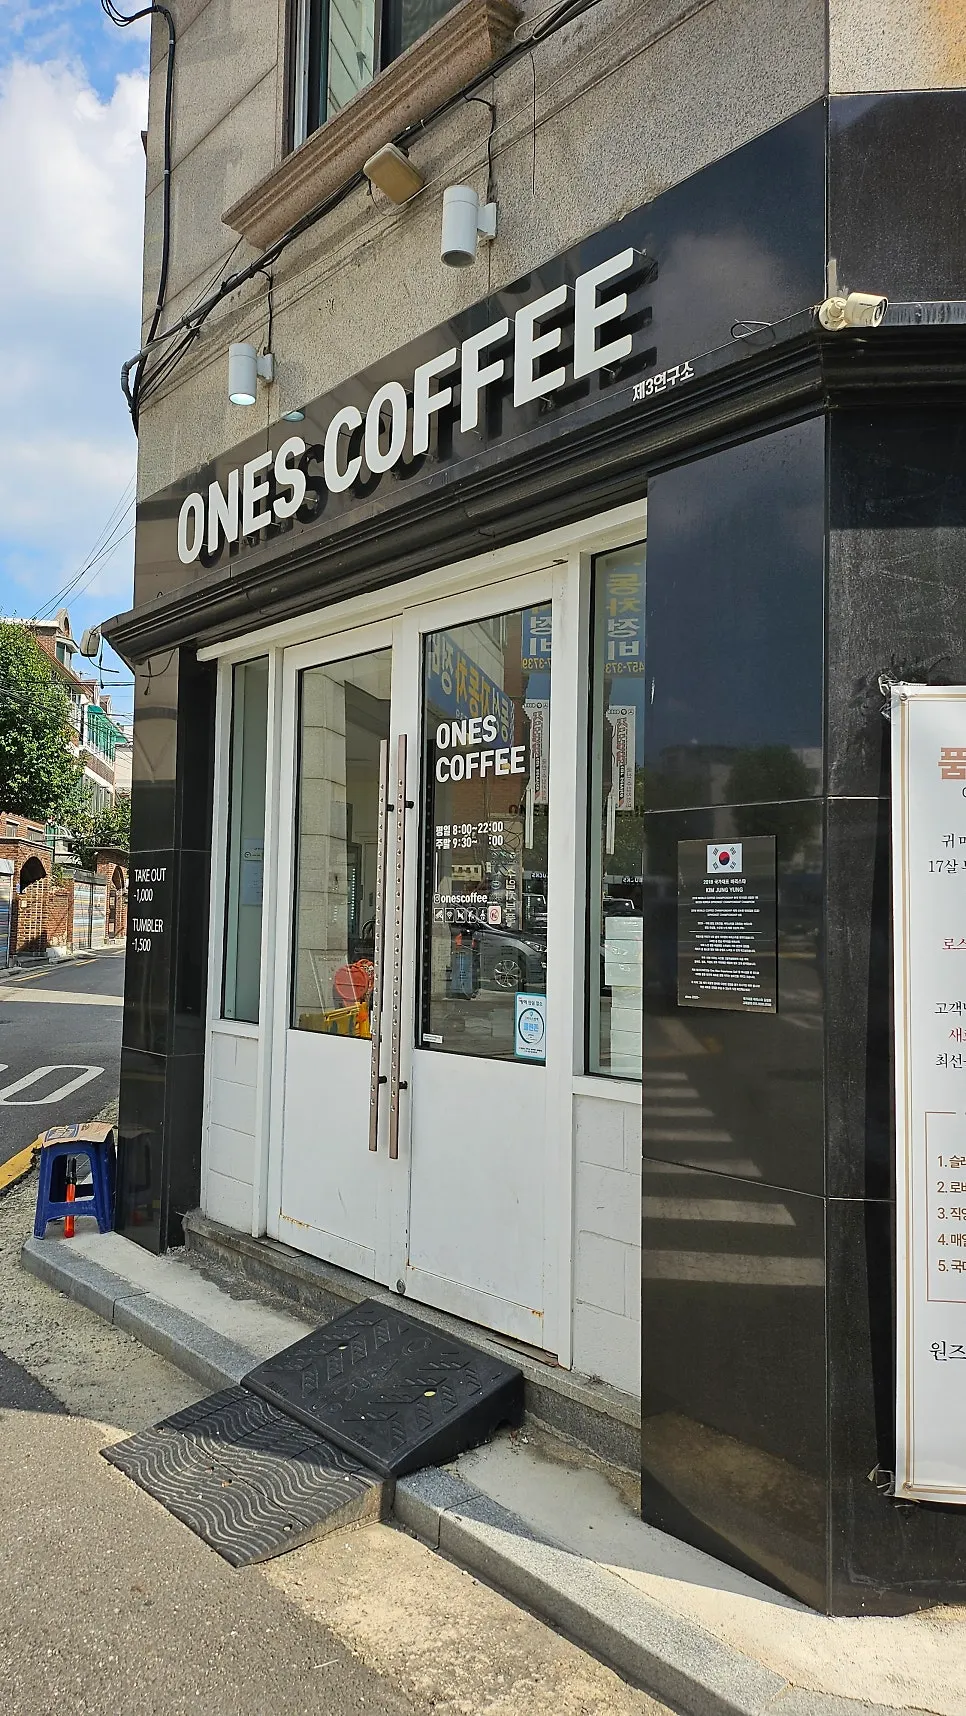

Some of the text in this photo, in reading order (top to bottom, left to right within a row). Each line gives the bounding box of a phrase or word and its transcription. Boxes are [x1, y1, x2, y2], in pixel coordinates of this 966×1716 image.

[632, 361, 695, 402] 제3연구소
[177, 246, 635, 565] ONES COFFEE
[436, 714, 497, 750] ONES
[435, 745, 527, 783] COFFEE
[435, 821, 504, 837] 평일 8:00~22:00
[435, 838, 451, 850] 주말
[928, 859, 958, 874] 17살
[134, 868, 166, 882] TAKE OUT
[133, 888, 154, 903] -1,000
[132, 918, 164, 933] TUMBLER
[131, 938, 152, 953] -1,500
[935, 1052, 966, 1069] 최선
[937, 1156, 947, 1168] 1.
[936, 1181, 948, 1193] 2.
[937, 1207, 948, 1220] 3.
[937, 1233, 949, 1246] 4.
[938, 1260, 949, 1272] 5.
